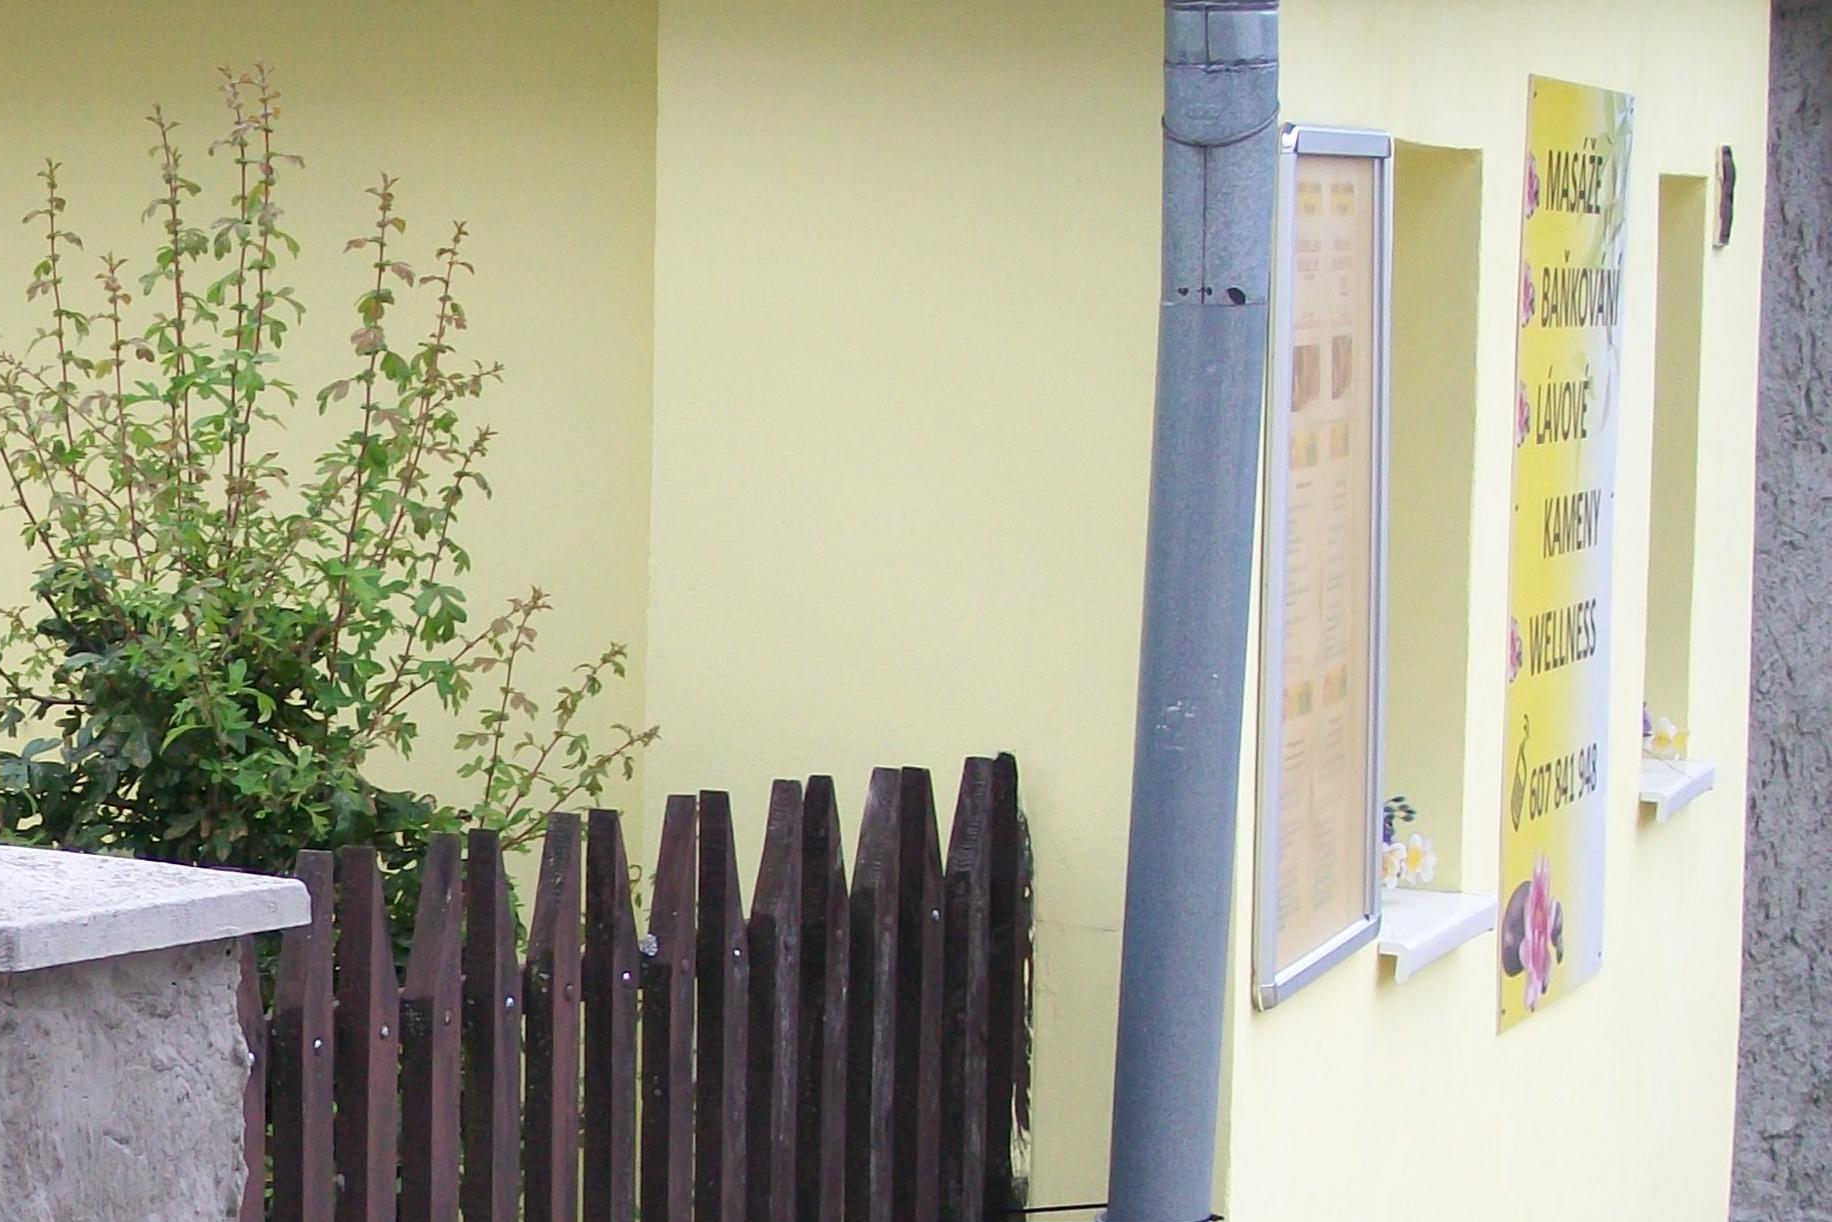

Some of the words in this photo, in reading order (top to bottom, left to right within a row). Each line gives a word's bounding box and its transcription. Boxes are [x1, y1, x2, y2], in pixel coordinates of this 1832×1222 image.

[1545, 137, 1603, 214] MASÁŽE
[1541, 250, 1623, 328] BAŇKOVÁNÍ
[1536, 364, 1589, 444] LÁVOVÉ
[1543, 489, 1602, 559] KAMENY
[1529, 598, 1597, 676] WELLNESS
[1529, 761, 1552, 821] 607
[1555, 752, 1575, 810] 841
[1578, 743, 1598, 800] 948
